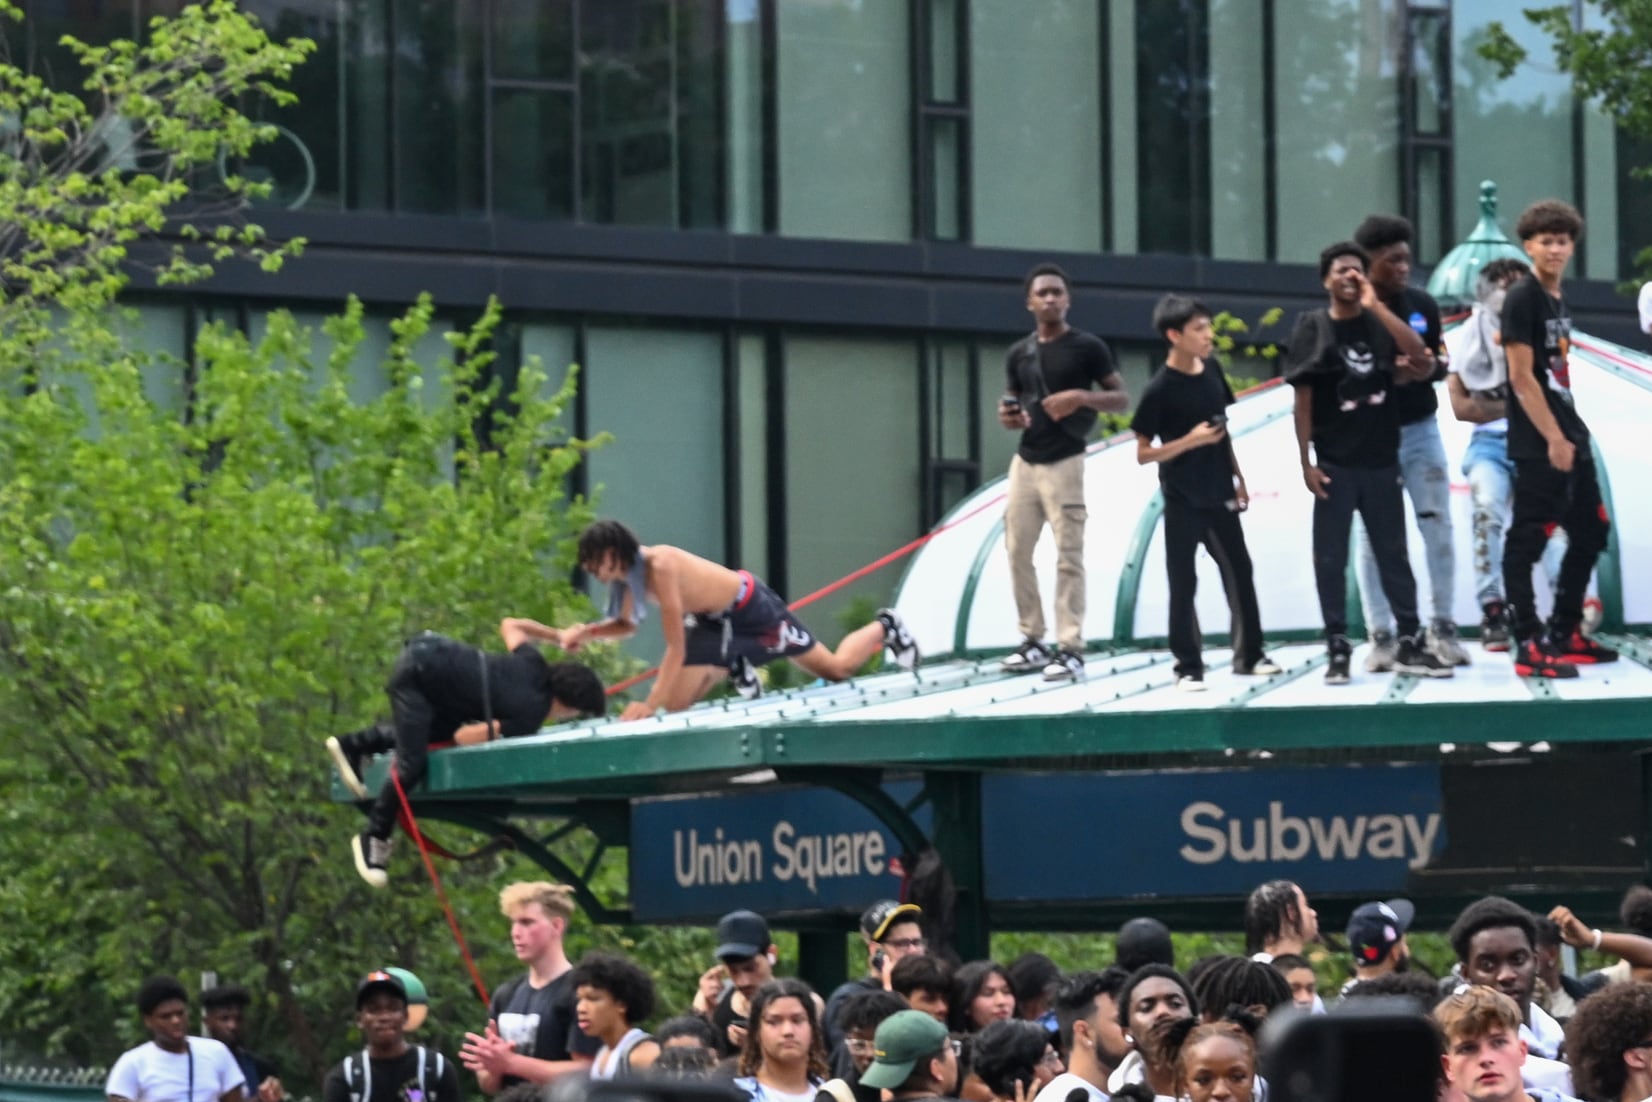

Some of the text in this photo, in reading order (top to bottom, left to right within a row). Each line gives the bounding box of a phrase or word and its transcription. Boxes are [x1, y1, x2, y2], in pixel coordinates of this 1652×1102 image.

[673, 820, 886, 895] Union Square
[1179, 801, 1441, 869] Subway
